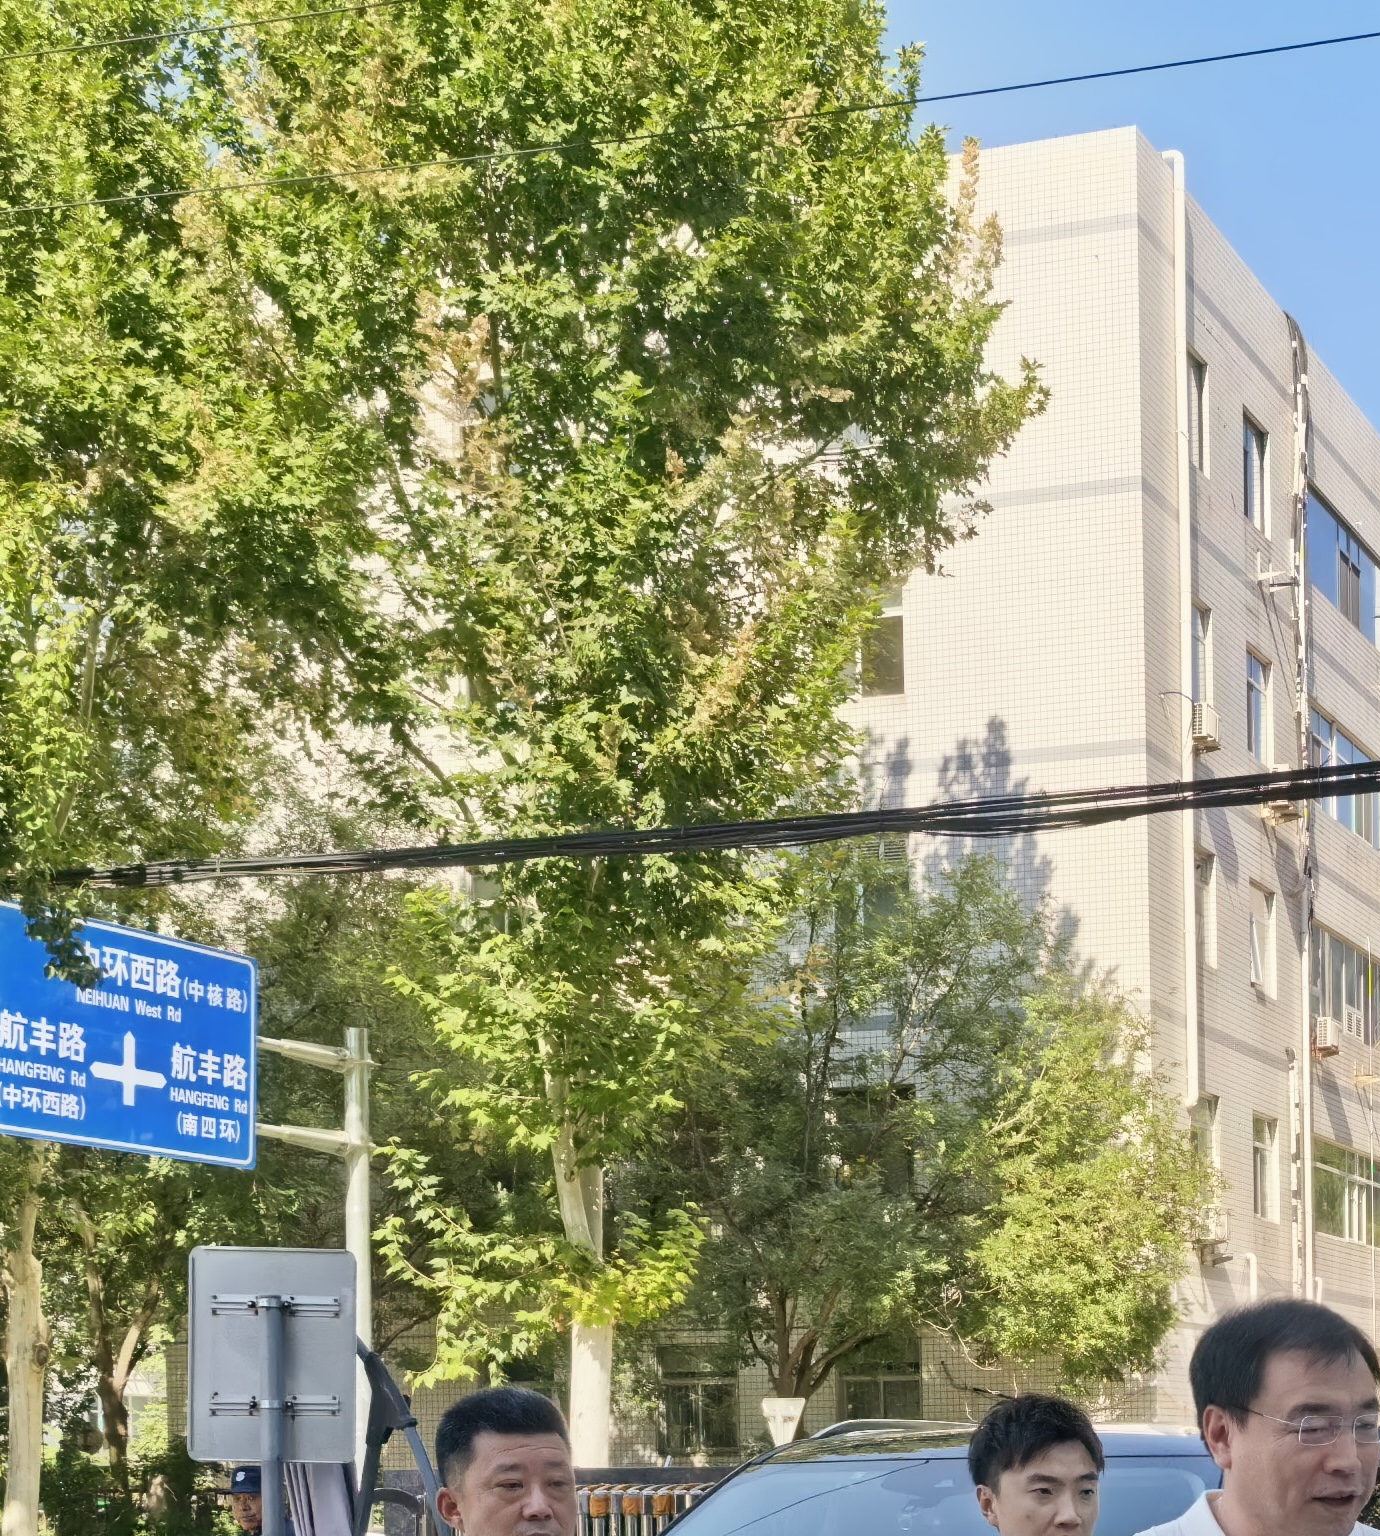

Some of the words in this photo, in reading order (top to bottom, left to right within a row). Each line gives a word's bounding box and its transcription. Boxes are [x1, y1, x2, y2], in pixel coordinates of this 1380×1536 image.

[76, 987, 129, 1012] NEIHUAN
[135, 999, 162, 1019] West
[167, 1005, 182, 1023] Rd
[0, 1009, 86, 1062] 航丰路
[0, 1057, 65, 1084] HANGFENG
[71, 1070, 86, 1088] Rd
[171, 1041, 248, 1091] 航丰路
[170, 1086, 229, 1111] HANGFENG
[234, 1097, 247, 1114] Rd
[177, 1110, 241, 1144] (南四环)
